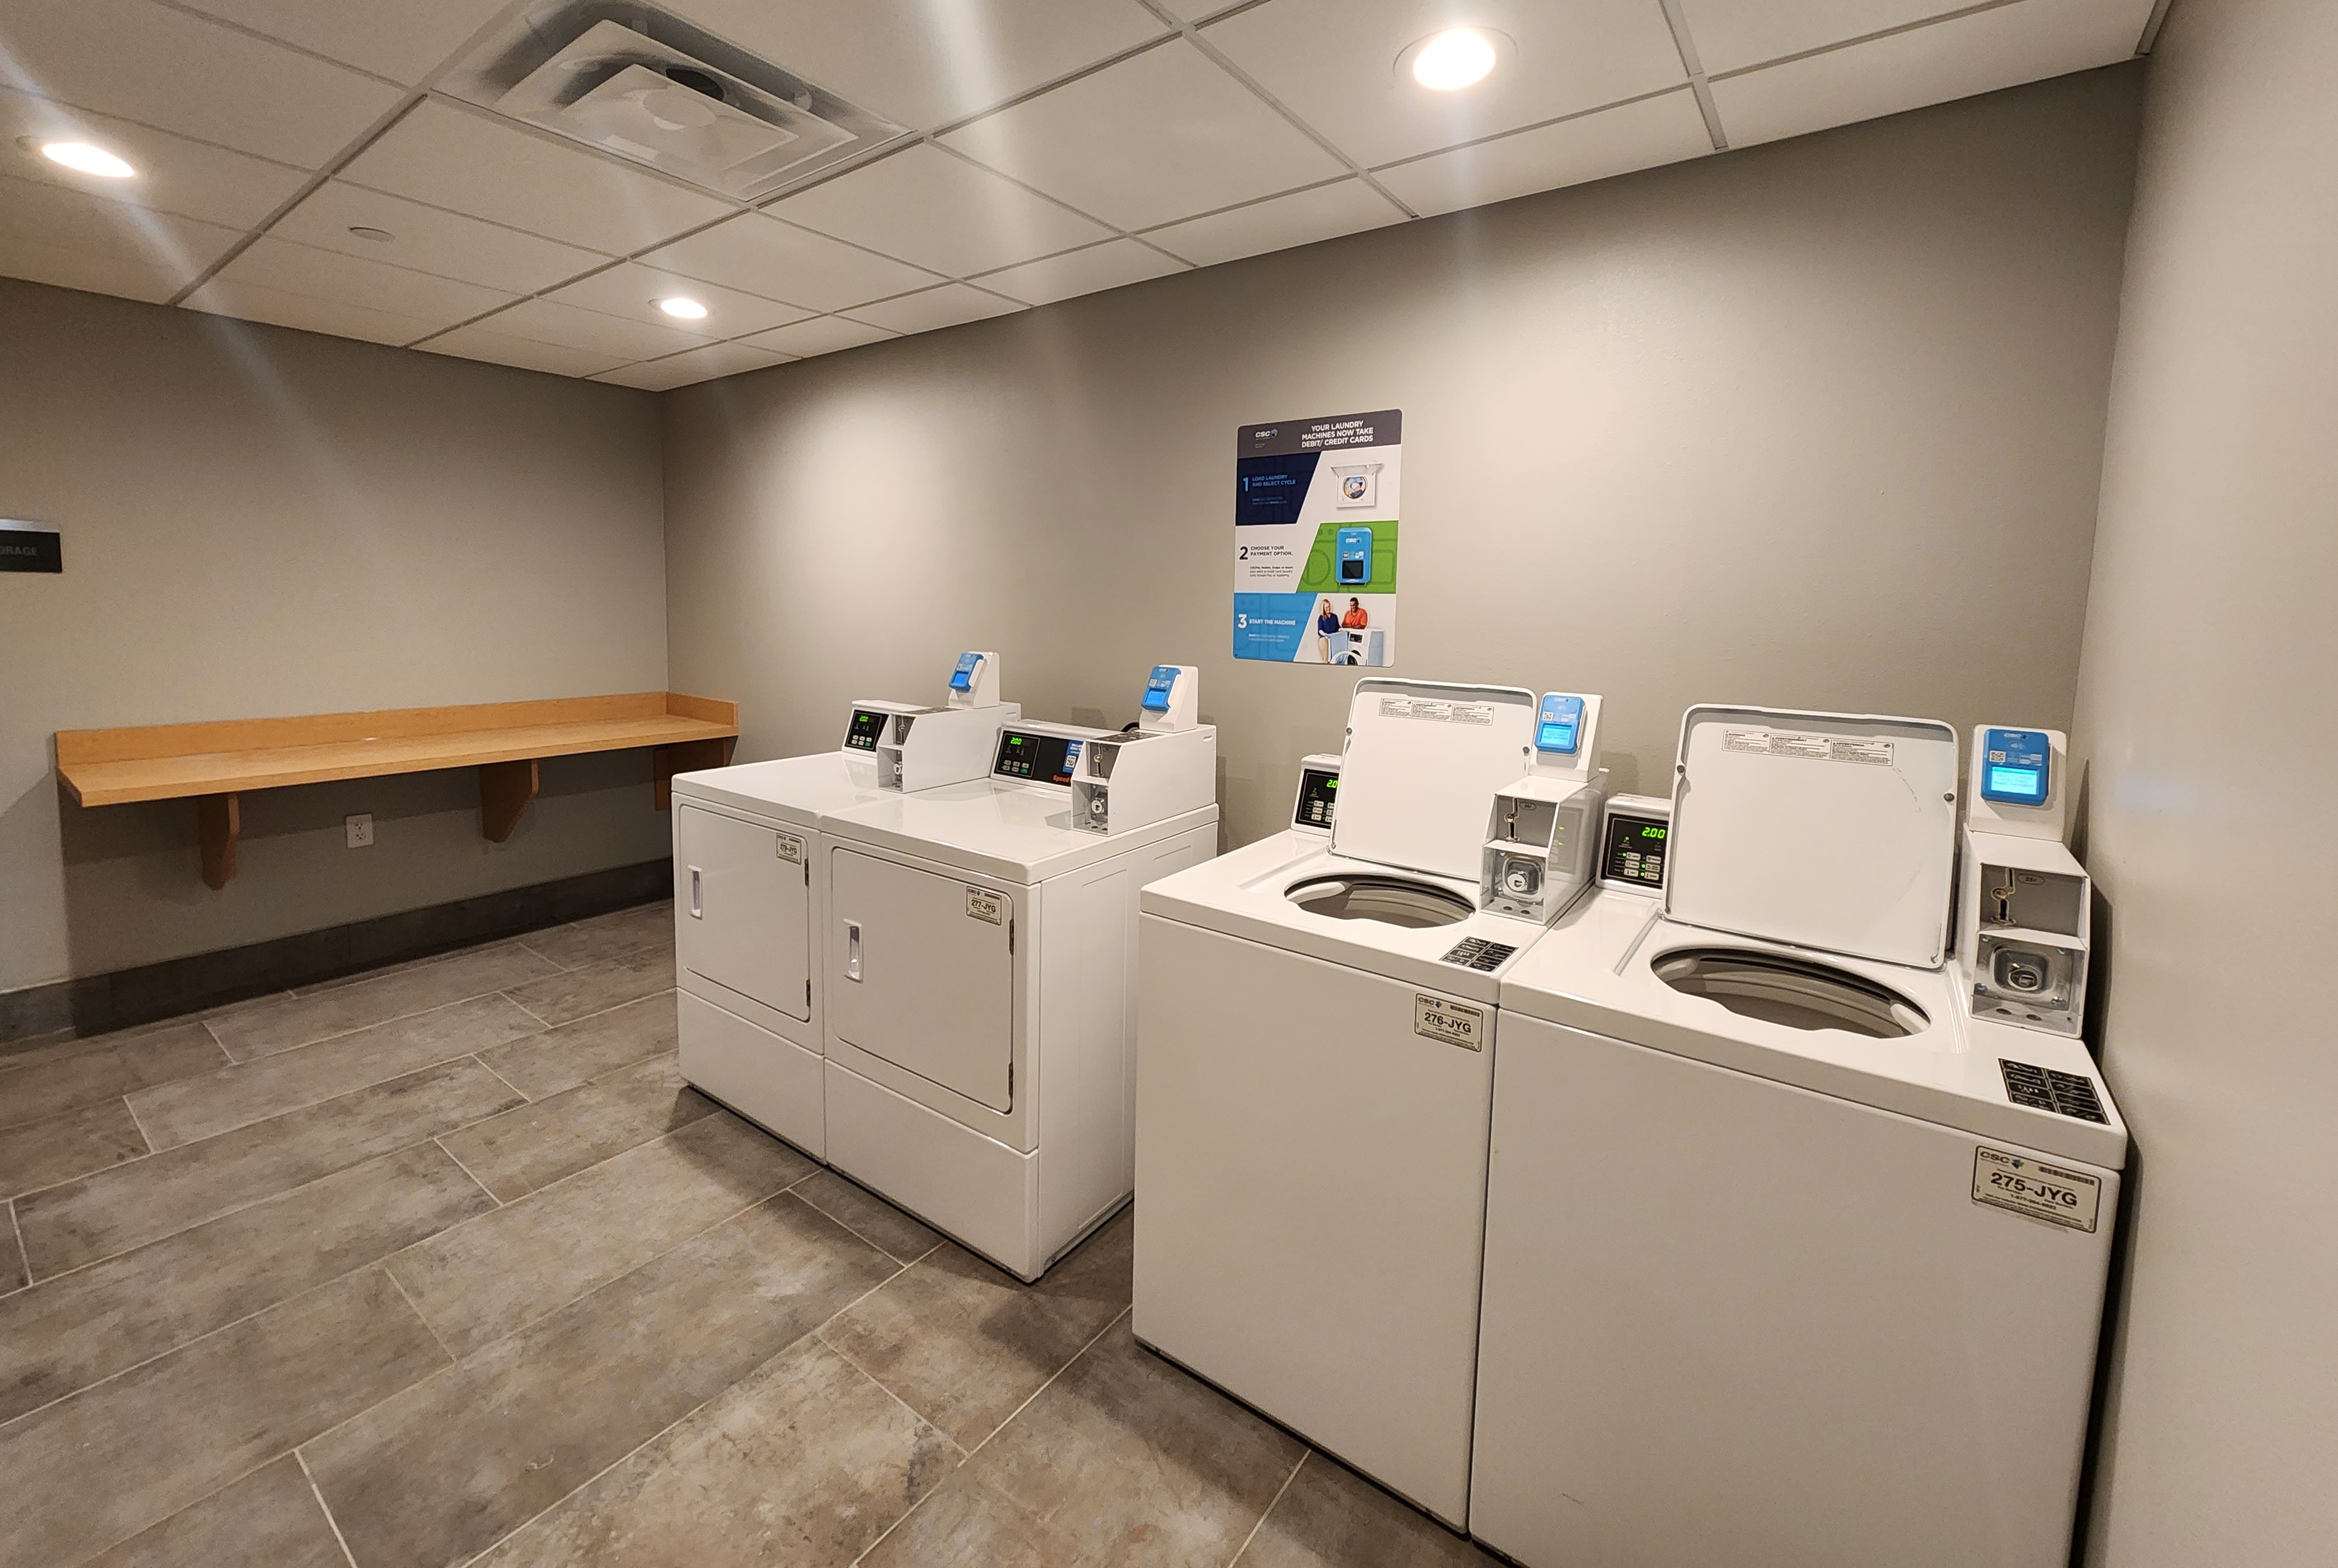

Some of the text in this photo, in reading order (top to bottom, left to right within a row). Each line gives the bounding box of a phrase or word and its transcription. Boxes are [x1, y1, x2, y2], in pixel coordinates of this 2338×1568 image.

[1311, 420, 1363, 432] YOUR LAUNDRY
[1301, 427, 1374, 440] MACHINES NOW TAKE
[1301, 435, 1373, 448] DEBIT/ CREDIT CARDS
[1243, 477, 1249, 492] 1
[1239, 546, 1248, 560] 2
[1238, 614, 1247, 628] 3
[1052, 774, 1070, 783] Speed
[1642, 826, 1666, 839] 2.00
[971, 899, 996, 913] 277-JYG
[1418, 997, 1434, 1005] CSC
[1424, 1012, 1471, 1033] 276-JYG
[1980, 1151, 2010, 1163] CSC
[1990, 1172, 2077, 1207] 275-JYG
